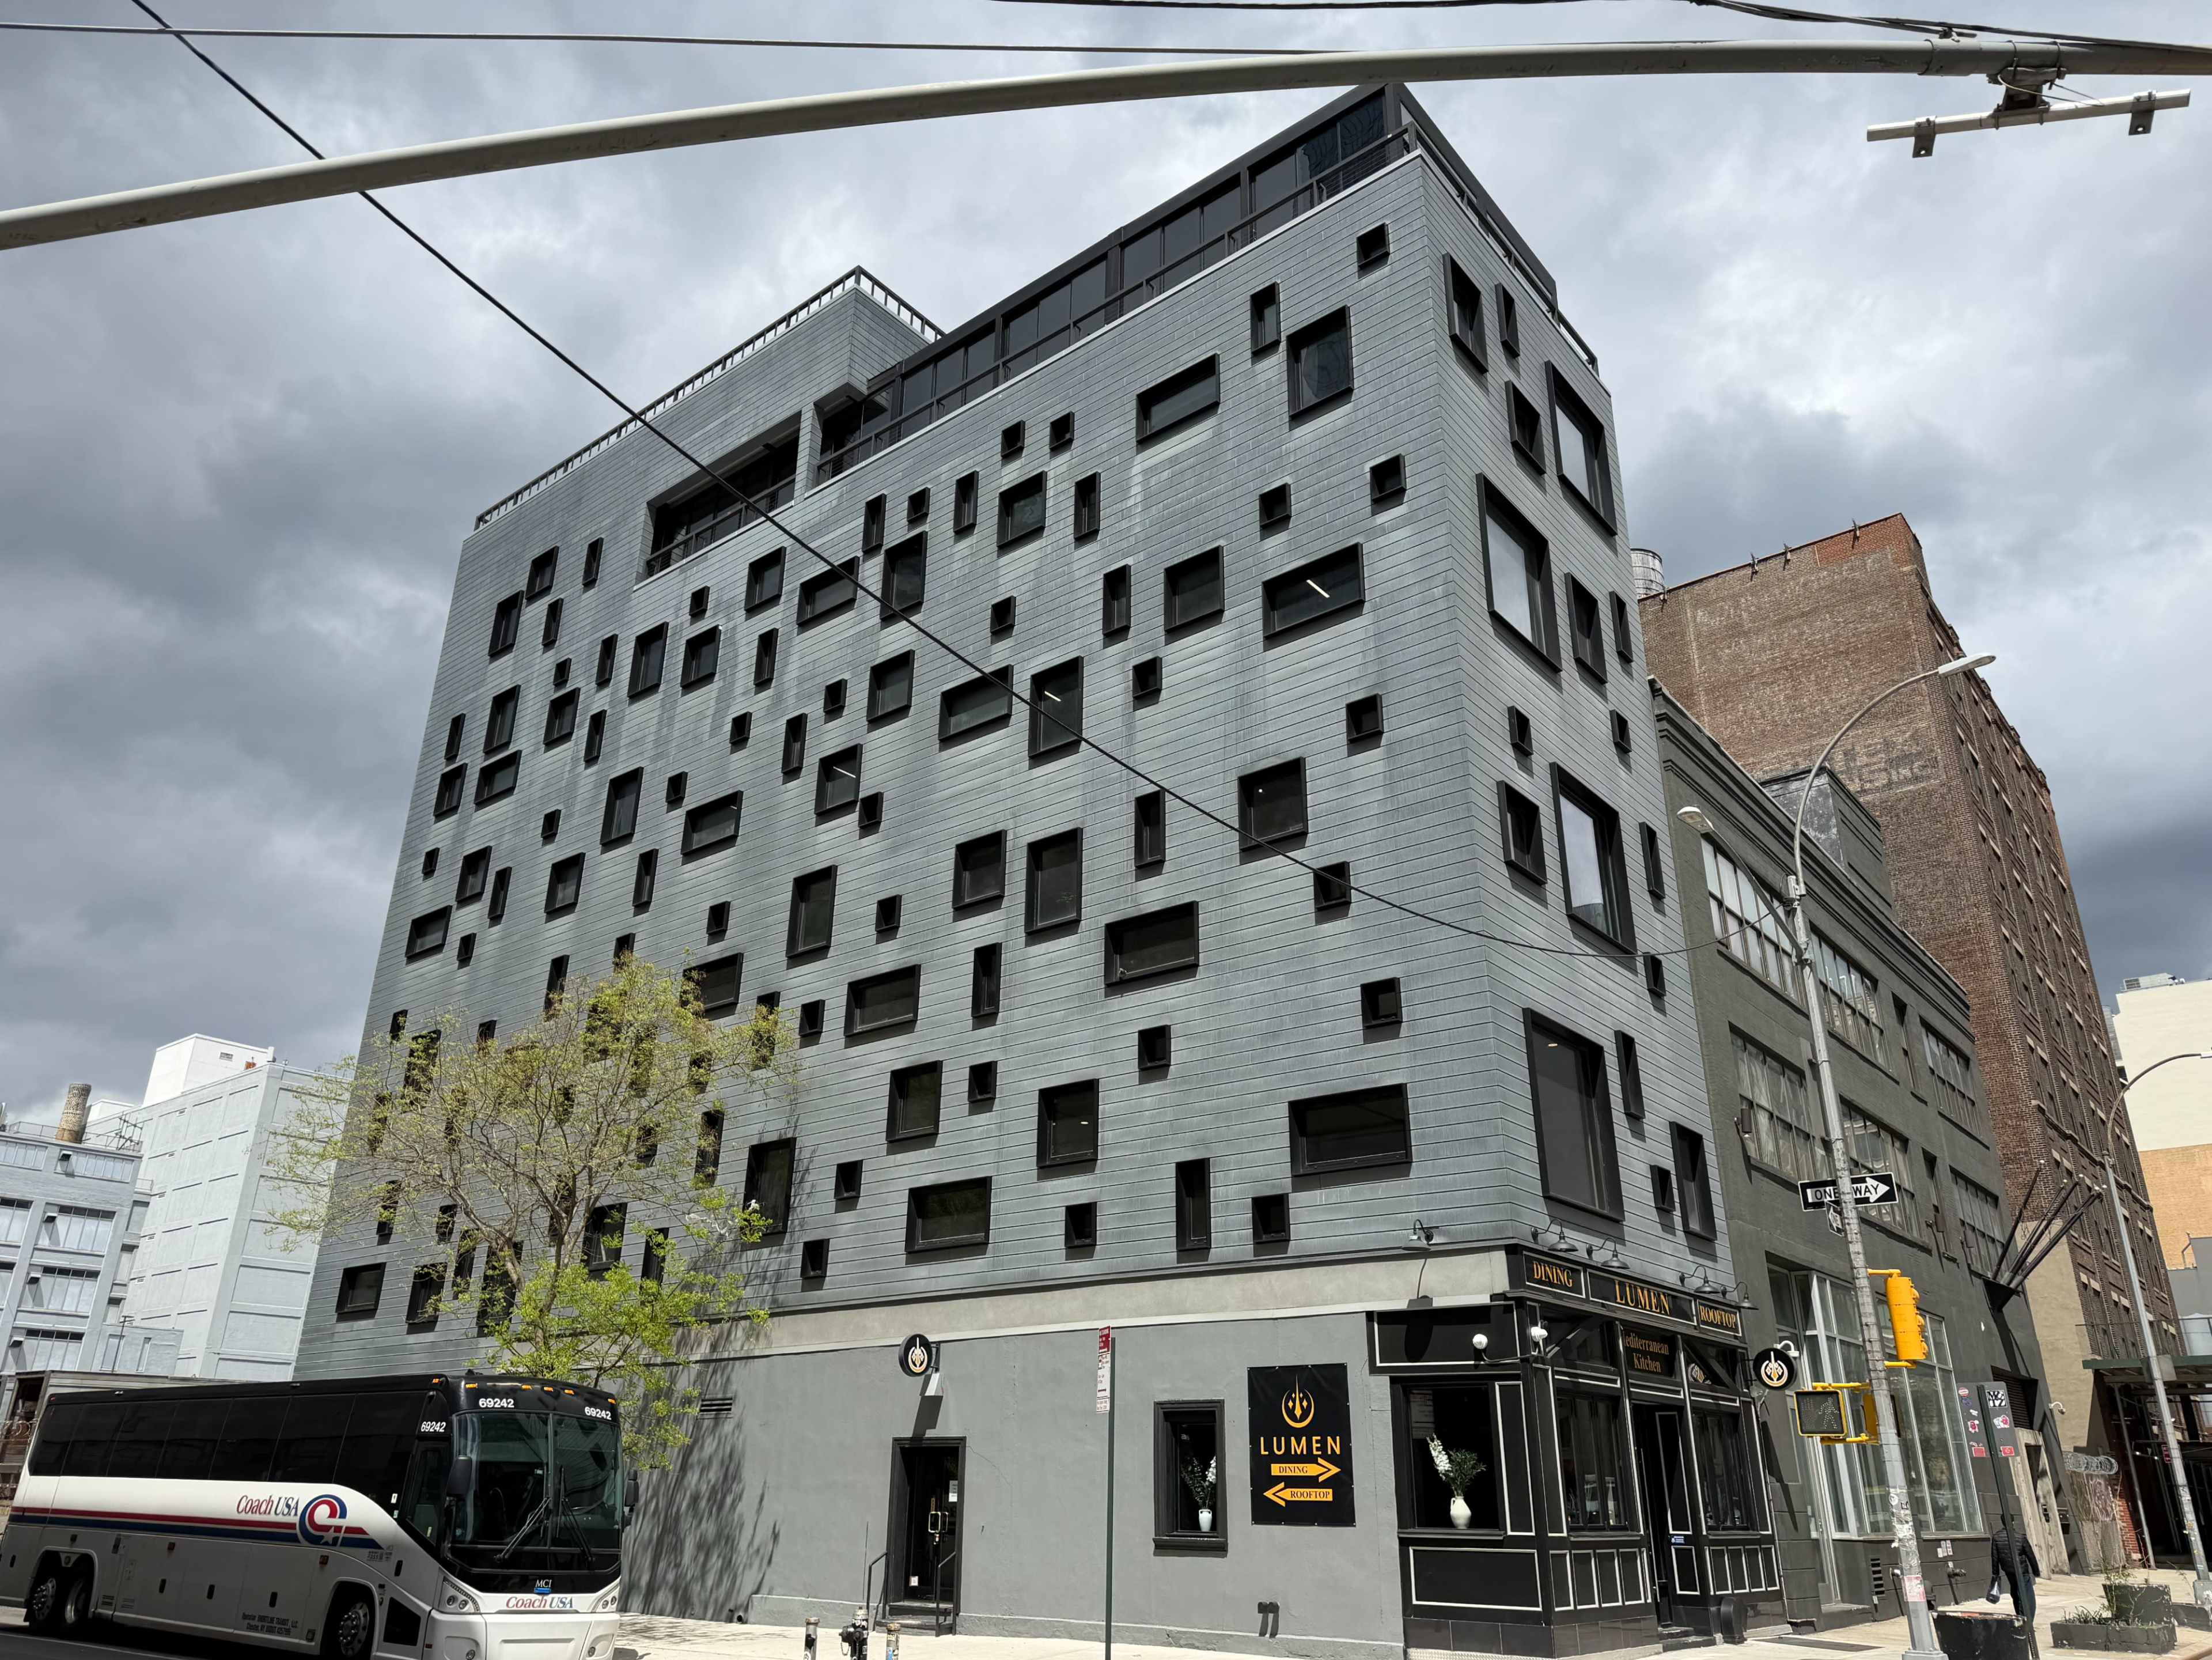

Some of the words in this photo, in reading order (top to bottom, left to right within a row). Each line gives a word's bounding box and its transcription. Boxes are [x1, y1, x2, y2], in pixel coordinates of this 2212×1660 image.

[1815, 1188, 1839, 1200] ONE
[1853, 1183, 1879, 1197] WAY
[1533, 1261, 1573, 1287] DINING
[1614, 1280, 1670, 1315] LUMEN
[1700, 1306, 1736, 1329] ROOFTOP
[1633, 1352, 1661, 1372] Kitchen
[479, 1398, 514, 1408] 69242
[585, 1406, 612, 1420] 69242
[421, 1421, 446, 1432] 69242
[1260, 1436, 1340, 1455] LUMEN
[1279, 1466, 1308, 1474] DINING
[1290, 1491, 1330, 1499] ROOFTOP
[237, 1495, 274, 1515] Coach
[275, 1497, 299, 1516] USA
[536, 1579, 552, 1587] MCI
[506, 1595, 547, 1608] Coach
[549, 1597, 573, 1608] USA
